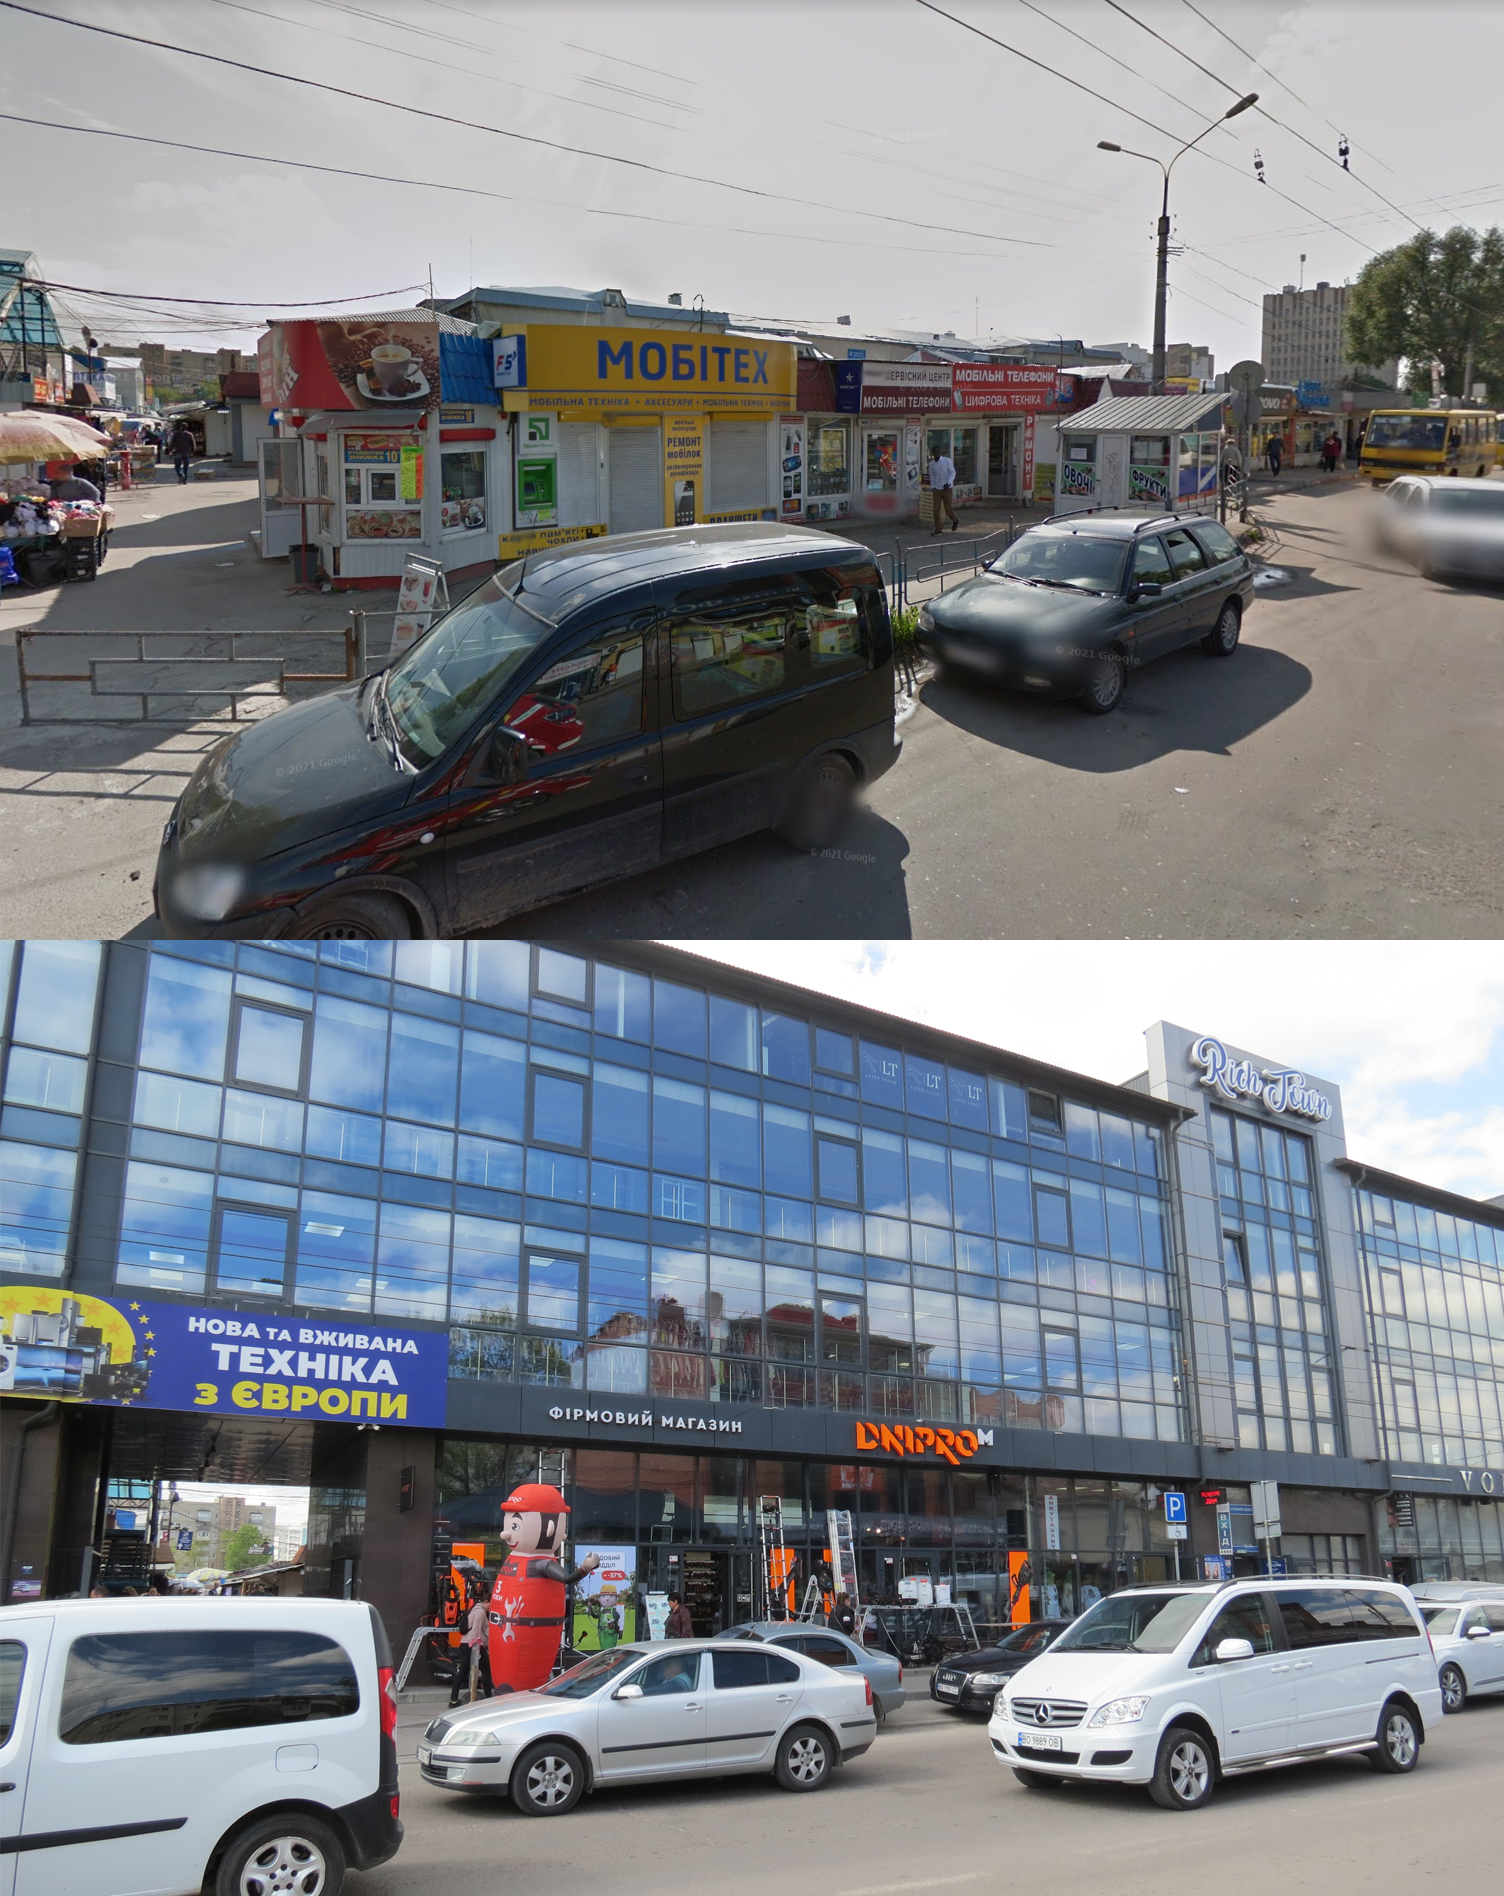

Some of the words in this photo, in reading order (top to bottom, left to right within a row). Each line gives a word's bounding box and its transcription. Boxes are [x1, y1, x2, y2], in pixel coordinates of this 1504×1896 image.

[597, 340, 769, 384] МОБІТЕХ
[929, 373, 950, 384] ЦЕНТР
[956, 369, 1004, 383] МОБІЛЬНІ
[1006, 370, 1054, 383] ТЕЛЕФОНИ
[529, 398, 585, 407] МОБІЛЬНА
[588, 398, 630, 407] ТЕХНІКА
[645, 398, 693, 407] АКСЕСУАРИ
[703, 399, 738, 407] МОБІЛЬНА
[863, 396, 906, 408] МОБІЛЬНІ
[908, 396, 950, 409] ТЕЛЕФОНИ
[965, 396, 1008, 407] ЦИФРОВА
[1010, 395, 1041, 406] ТЕХНІКА
[667, 436, 701, 447] РЕМОНТ
[1025, 416, 1033, 485] РЕМОНТ
[667, 448, 701, 459] мобілок
[1064, 464, 1092, 495] ОВОЧІ
[1132, 470, 1167, 499] ФРУКТИ
[882, 1060, 898, 1077] LT
[1191, 1036, 1264, 1099] Rich
[1262, 1068, 1333, 1122] Town
[925, 1073, 941, 1089] LT
[968, 1085, 983, 1101] LT
[188, 1316, 261, 1339] НОВА
[299, 1328, 419, 1355] ВЖИВАНА
[211, 1342, 399, 1386] ТЕХНІКА
[231, 1380, 408, 1419] ЄВРОПИ
[549, 1406, 653, 1427] ФІРМОВИЙ
[661, 1415, 742, 1433] МАГАЗИН
[1459, 1470, 1504, 1494] VO
[1170, 1497, 1181, 1517] P
[1220, 1514, 1230, 1546] ВХІД
